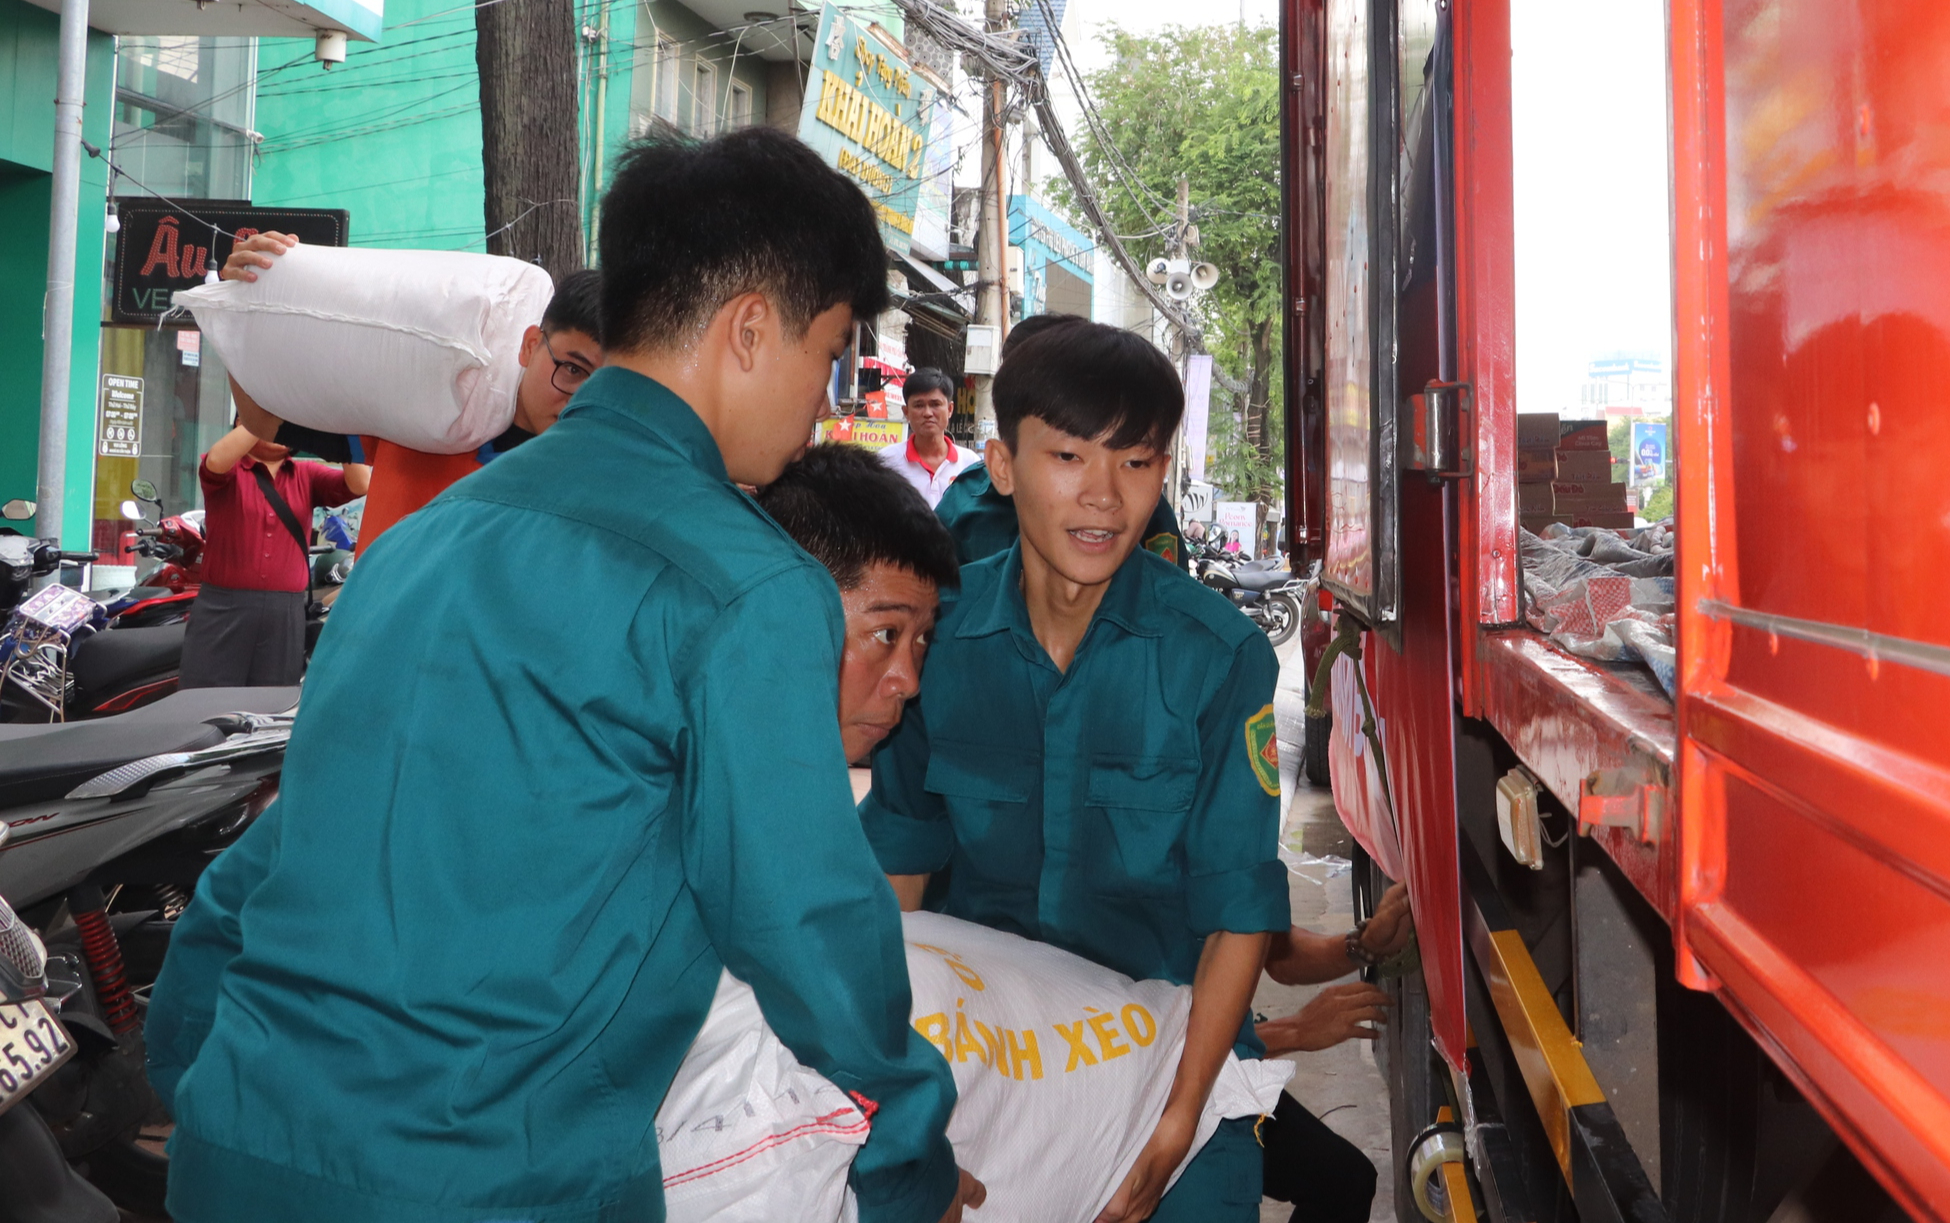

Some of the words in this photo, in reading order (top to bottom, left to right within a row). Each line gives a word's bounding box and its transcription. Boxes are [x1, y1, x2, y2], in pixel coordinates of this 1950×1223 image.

[816, 69, 869, 145] KHẢI
[862, 101, 914, 172] HOÀN
[906, 134, 923, 180] 2
[139, 215, 208, 278] Âu
[108, 377, 125, 388] OPEN
[125, 379, 139, 389] TIME
[825, 430, 858, 442] KI
[859, 430, 899, 444] HOÀN
[914, 996, 1044, 1081] BÁNH
[1052, 1002, 1158, 1073] XÈO
